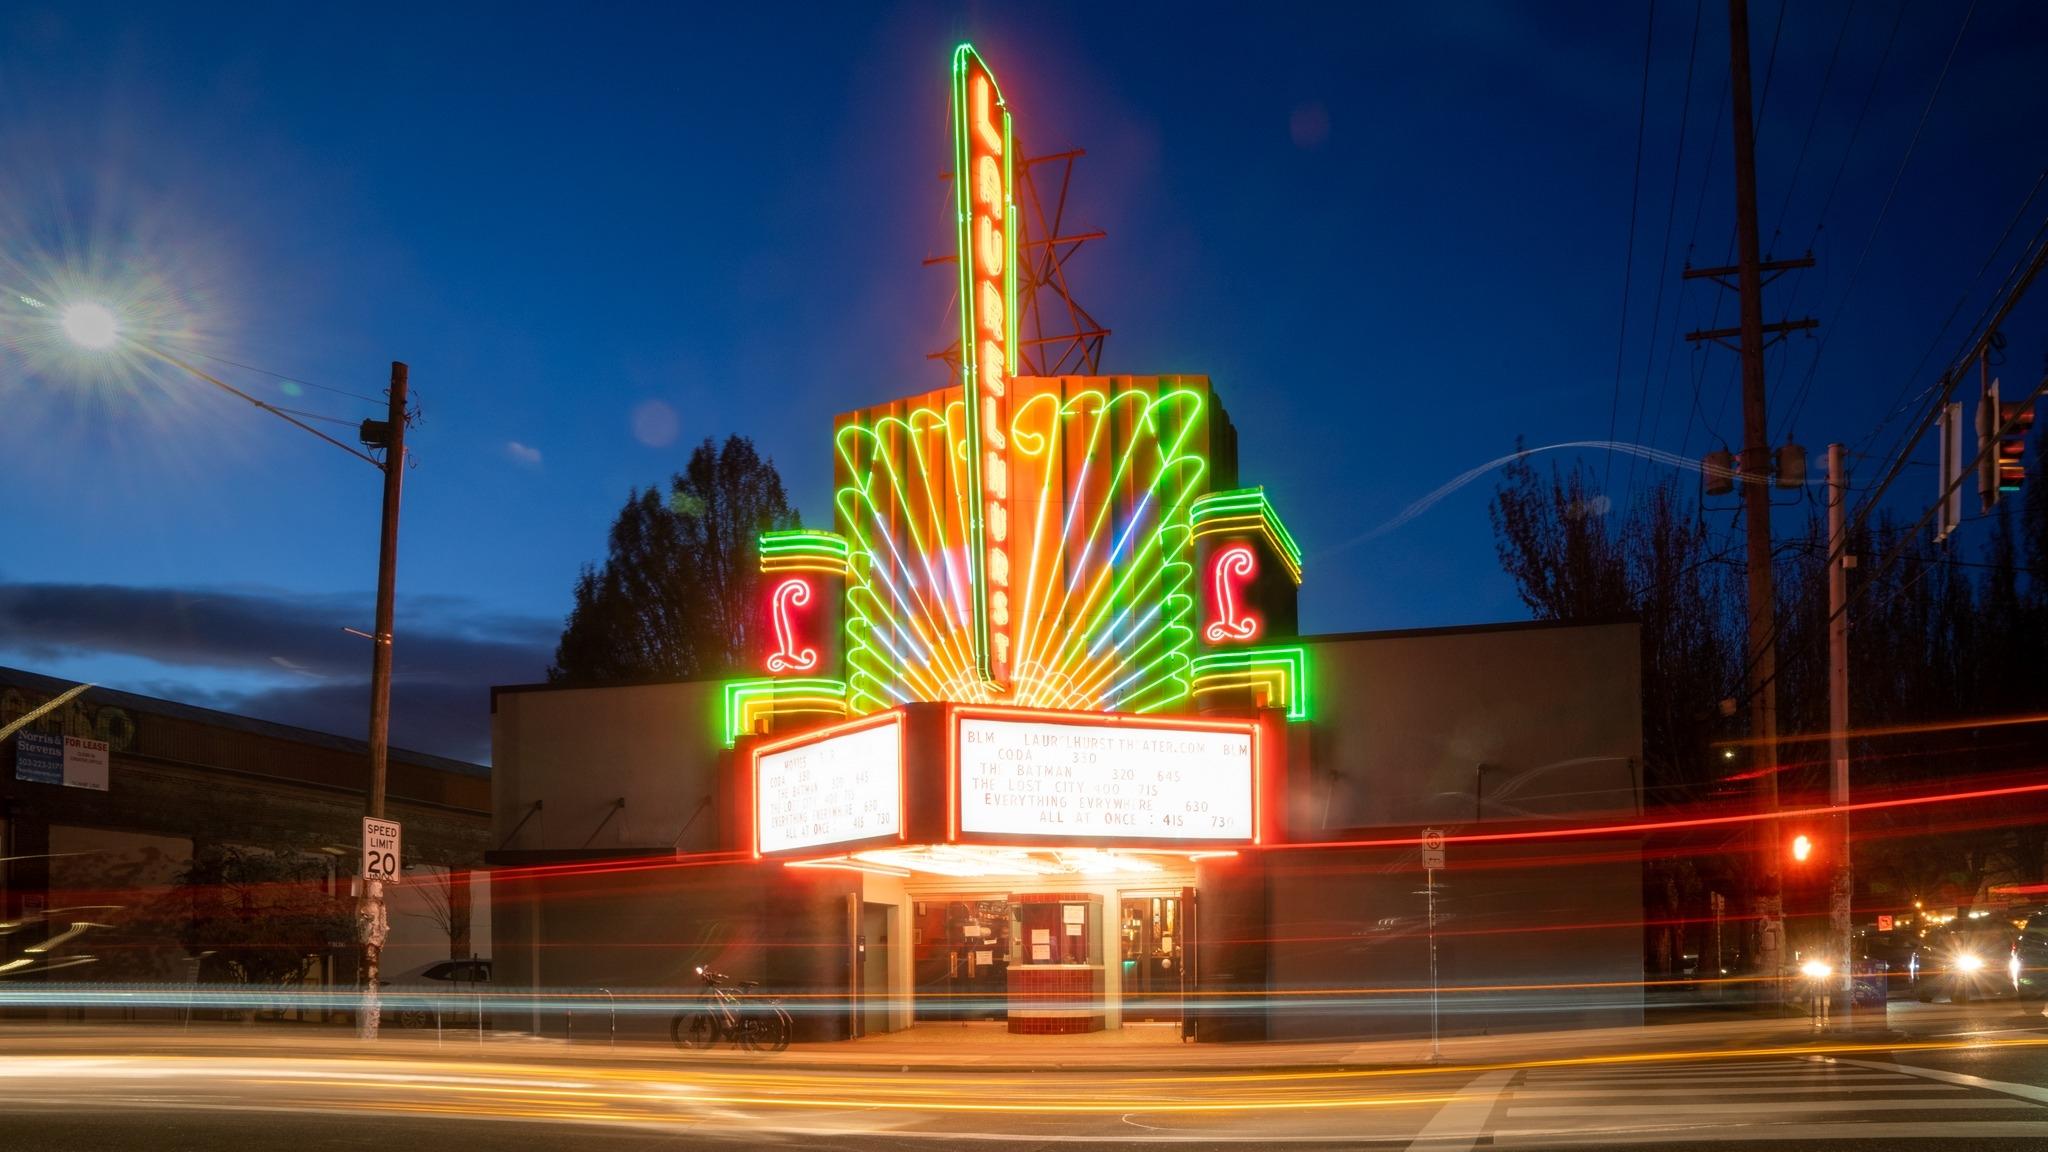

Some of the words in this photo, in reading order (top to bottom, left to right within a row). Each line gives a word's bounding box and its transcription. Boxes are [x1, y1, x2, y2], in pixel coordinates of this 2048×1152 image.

[977, 75, 1009, 664] LAURELHURST
[1206, 548, 1257, 641] L
[767, 579, 817, 672] L
[18, 730, 53, 744] Norris
[65, 738, 81, 749] FOR
[83, 740, 108, 752] LEASE
[967, 731, 995, 743] BLM
[1024, 733, 1114, 750] LAURLHURST
[1119, 738, 1206, 753] THATER.COM
[17, 741, 62, 756] Stevens
[998, 748, 1032, 761] CODA
[1017, 764, 1072, 778] BATMAN
[1112, 768, 1135, 780] 320
[1157, 771, 1181, 782] 645
[972, 778, 996, 791] THE
[1008, 778, 1042, 792] LOST
[1055, 781, 1085, 793] CITY
[1138, 784, 1159, 796] 715
[985, 792, 1067, 808] EVERYTHING
[1079, 797, 1152, 810] EVRYWHRE
[1185, 801, 1209, 812] 630
[1040, 810, 1064, 823] ALL
[1075, 812, 1090, 824] AT
[1104, 812, 1137, 825] ONCE
[1163, 814, 1184, 827] 415
[367, 824, 397, 838] SPEED
[370, 838, 394, 850] LIMIT
[367, 850, 396, 876] 20
